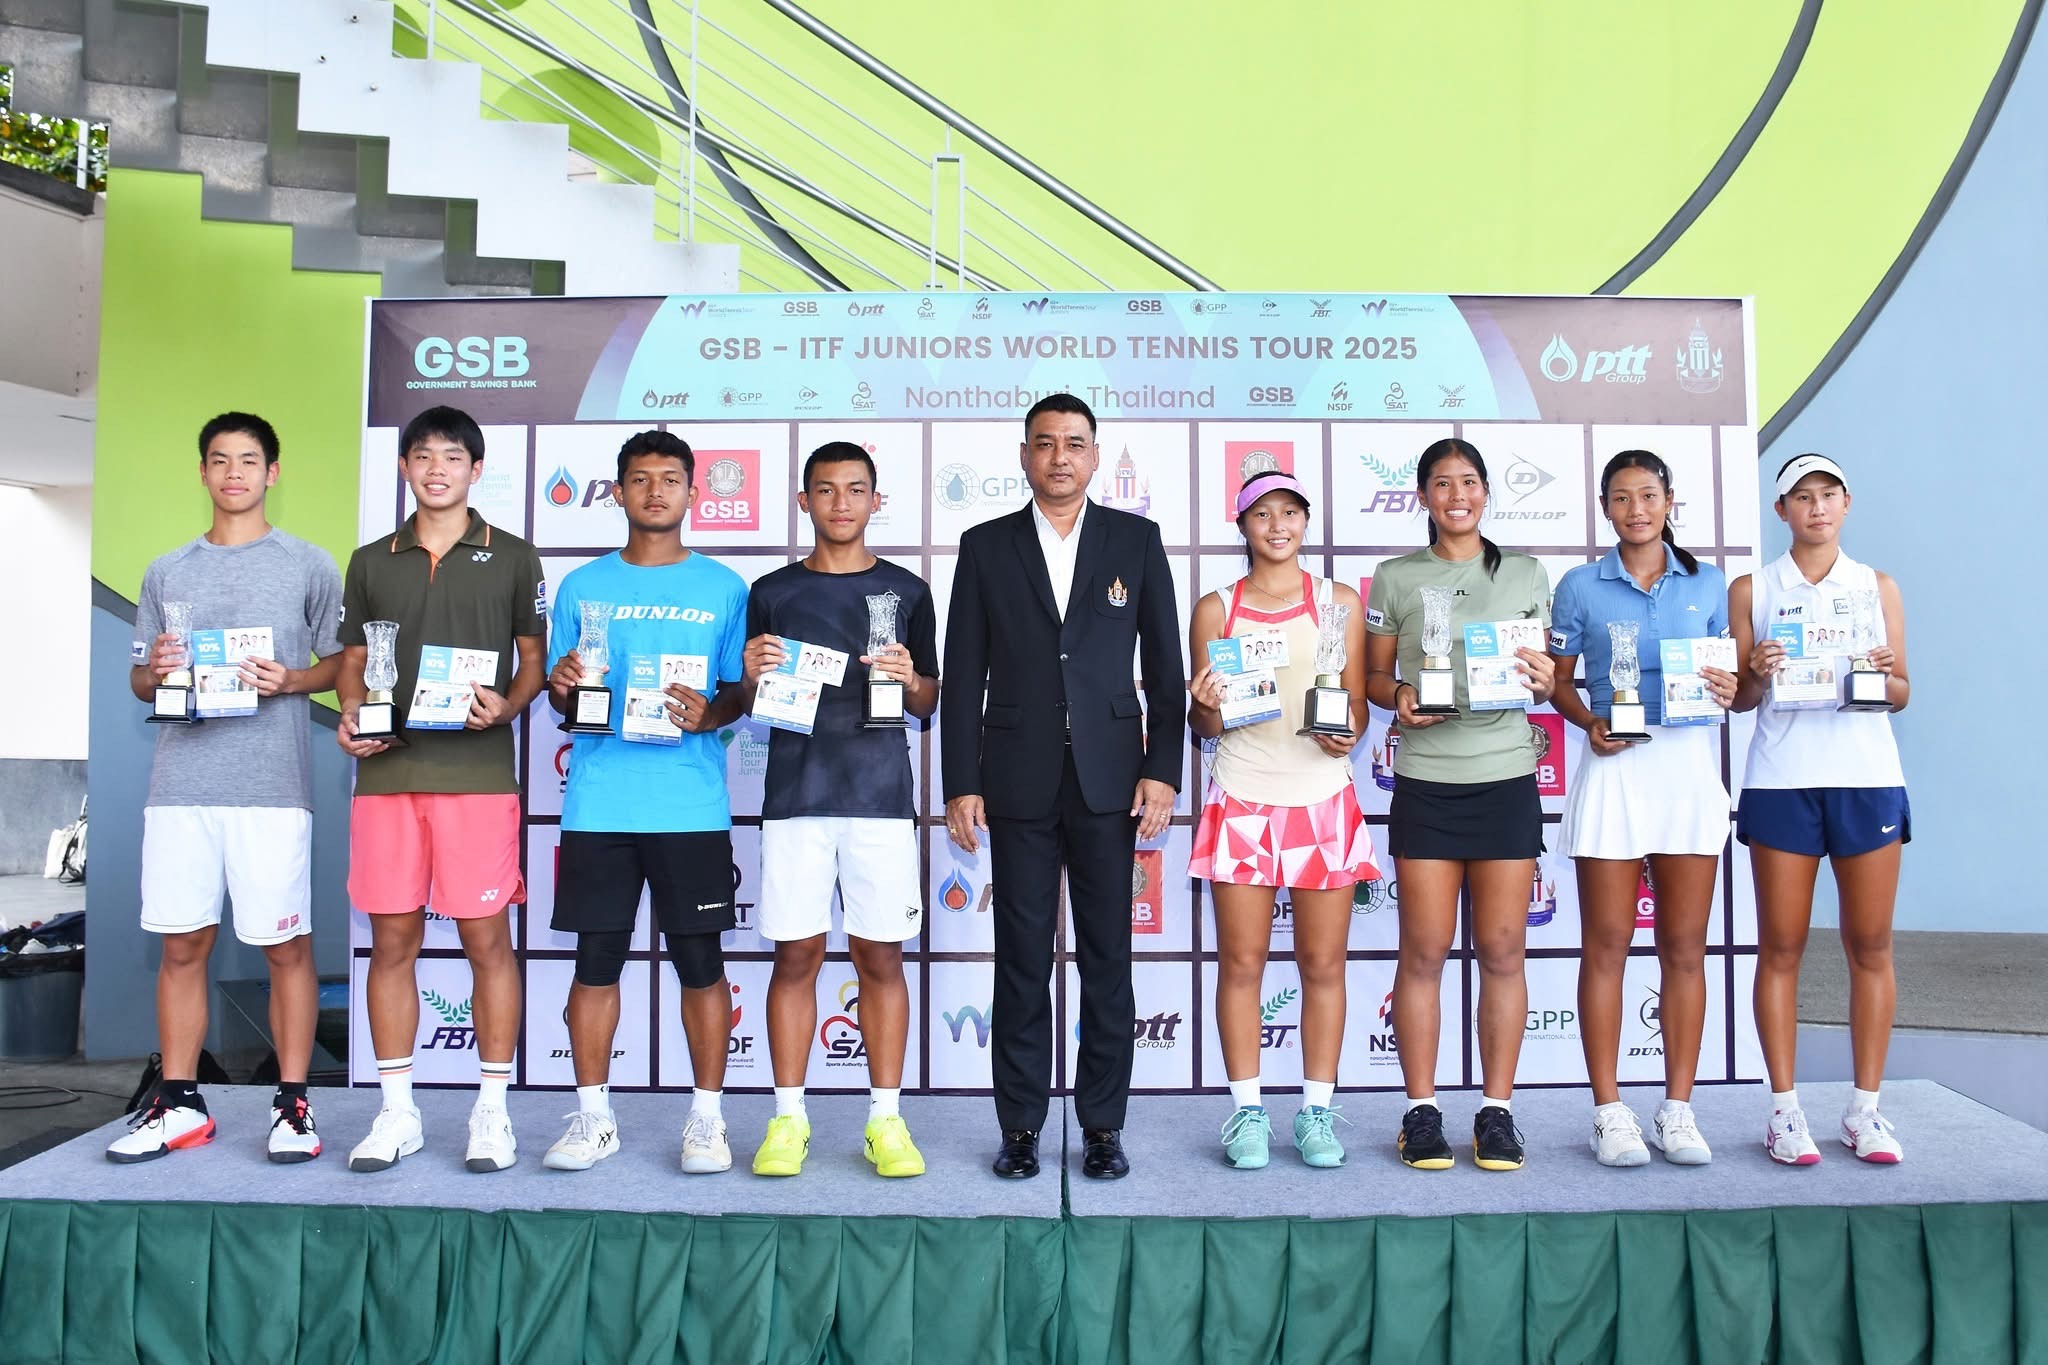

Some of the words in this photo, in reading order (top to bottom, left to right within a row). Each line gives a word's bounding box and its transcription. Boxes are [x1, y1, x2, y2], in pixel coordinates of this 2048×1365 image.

[784, 302, 818, 313] GSB
[861, 304, 885, 316] ptt
[1127, 300, 1162, 312] GSB
[700, 337, 761, 360] GSB
[800, 336, 844, 359] ITF
[854, 336, 992, 359] JUNIORS
[1003, 335, 1117, 359] WORLD
[1127, 335, 1239, 359] TENNIS
[1250, 336, 1334, 359] TOUR
[1344, 336, 1417, 360] 2025
[414, 336, 530, 378] GSB
[1580, 343, 1653, 383] ptt
[406, 381, 468, 389] GOVERNMENT
[470, 380, 509, 389] SAVINGS
[511, 380, 537, 388] BANK
[1605, 373, 1648, 385] Group
[659, 391, 690, 408] ptt
[739, 392, 762, 402] GPP
[1087, 385, 1215, 408] Thailand
[1249, 386, 1294, 402] GSB
[853, 401, 876, 409] SAT
[1327, 402, 1353, 411] NSDF
[1387, 401, 1408, 409] SAT
[1439, 398, 1465, 407] FBT
[700, 500, 750, 519] GSB
[1493, 511, 1567, 520] DUNLOP
[613, 605, 715, 625] DUNLOP
[1788, 606, 1803, 616] ptt
[1214, 652, 1237, 663] 10%
[633, 666, 655, 676] 10%
[738, 767, 765, 776] Junio
[1526, 1010, 1574, 1030] GPP
[1260, 1025, 1298, 1048] BT
[827, 1039, 867, 1058] SA
[1136, 1039, 1176, 1050] Group
[1627, 1047, 1665, 1056] DUN
